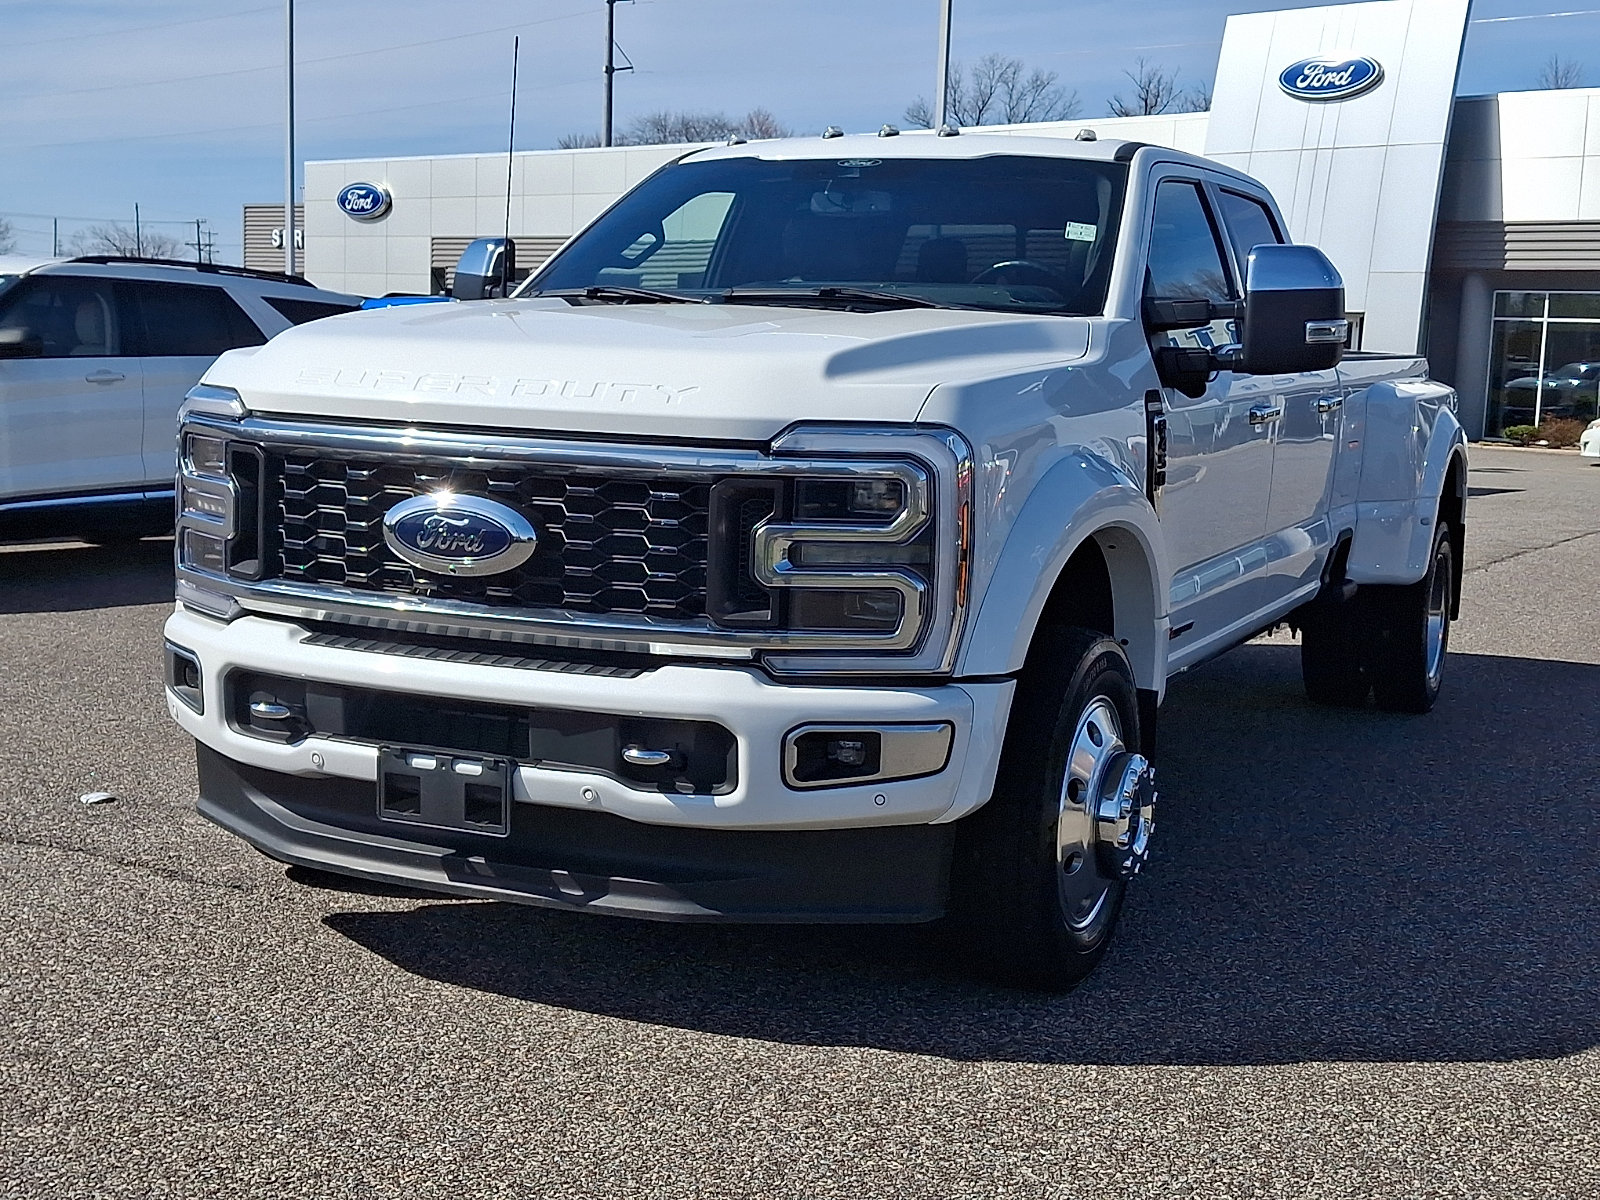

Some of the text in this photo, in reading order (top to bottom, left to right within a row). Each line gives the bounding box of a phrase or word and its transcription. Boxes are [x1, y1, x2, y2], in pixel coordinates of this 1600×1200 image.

[1296, 60, 1355, 88] Ford
[345, 190, 373, 210] Ford
[296, 368, 700, 404] SUPER DUTY
[416, 515, 485, 554] Ford
